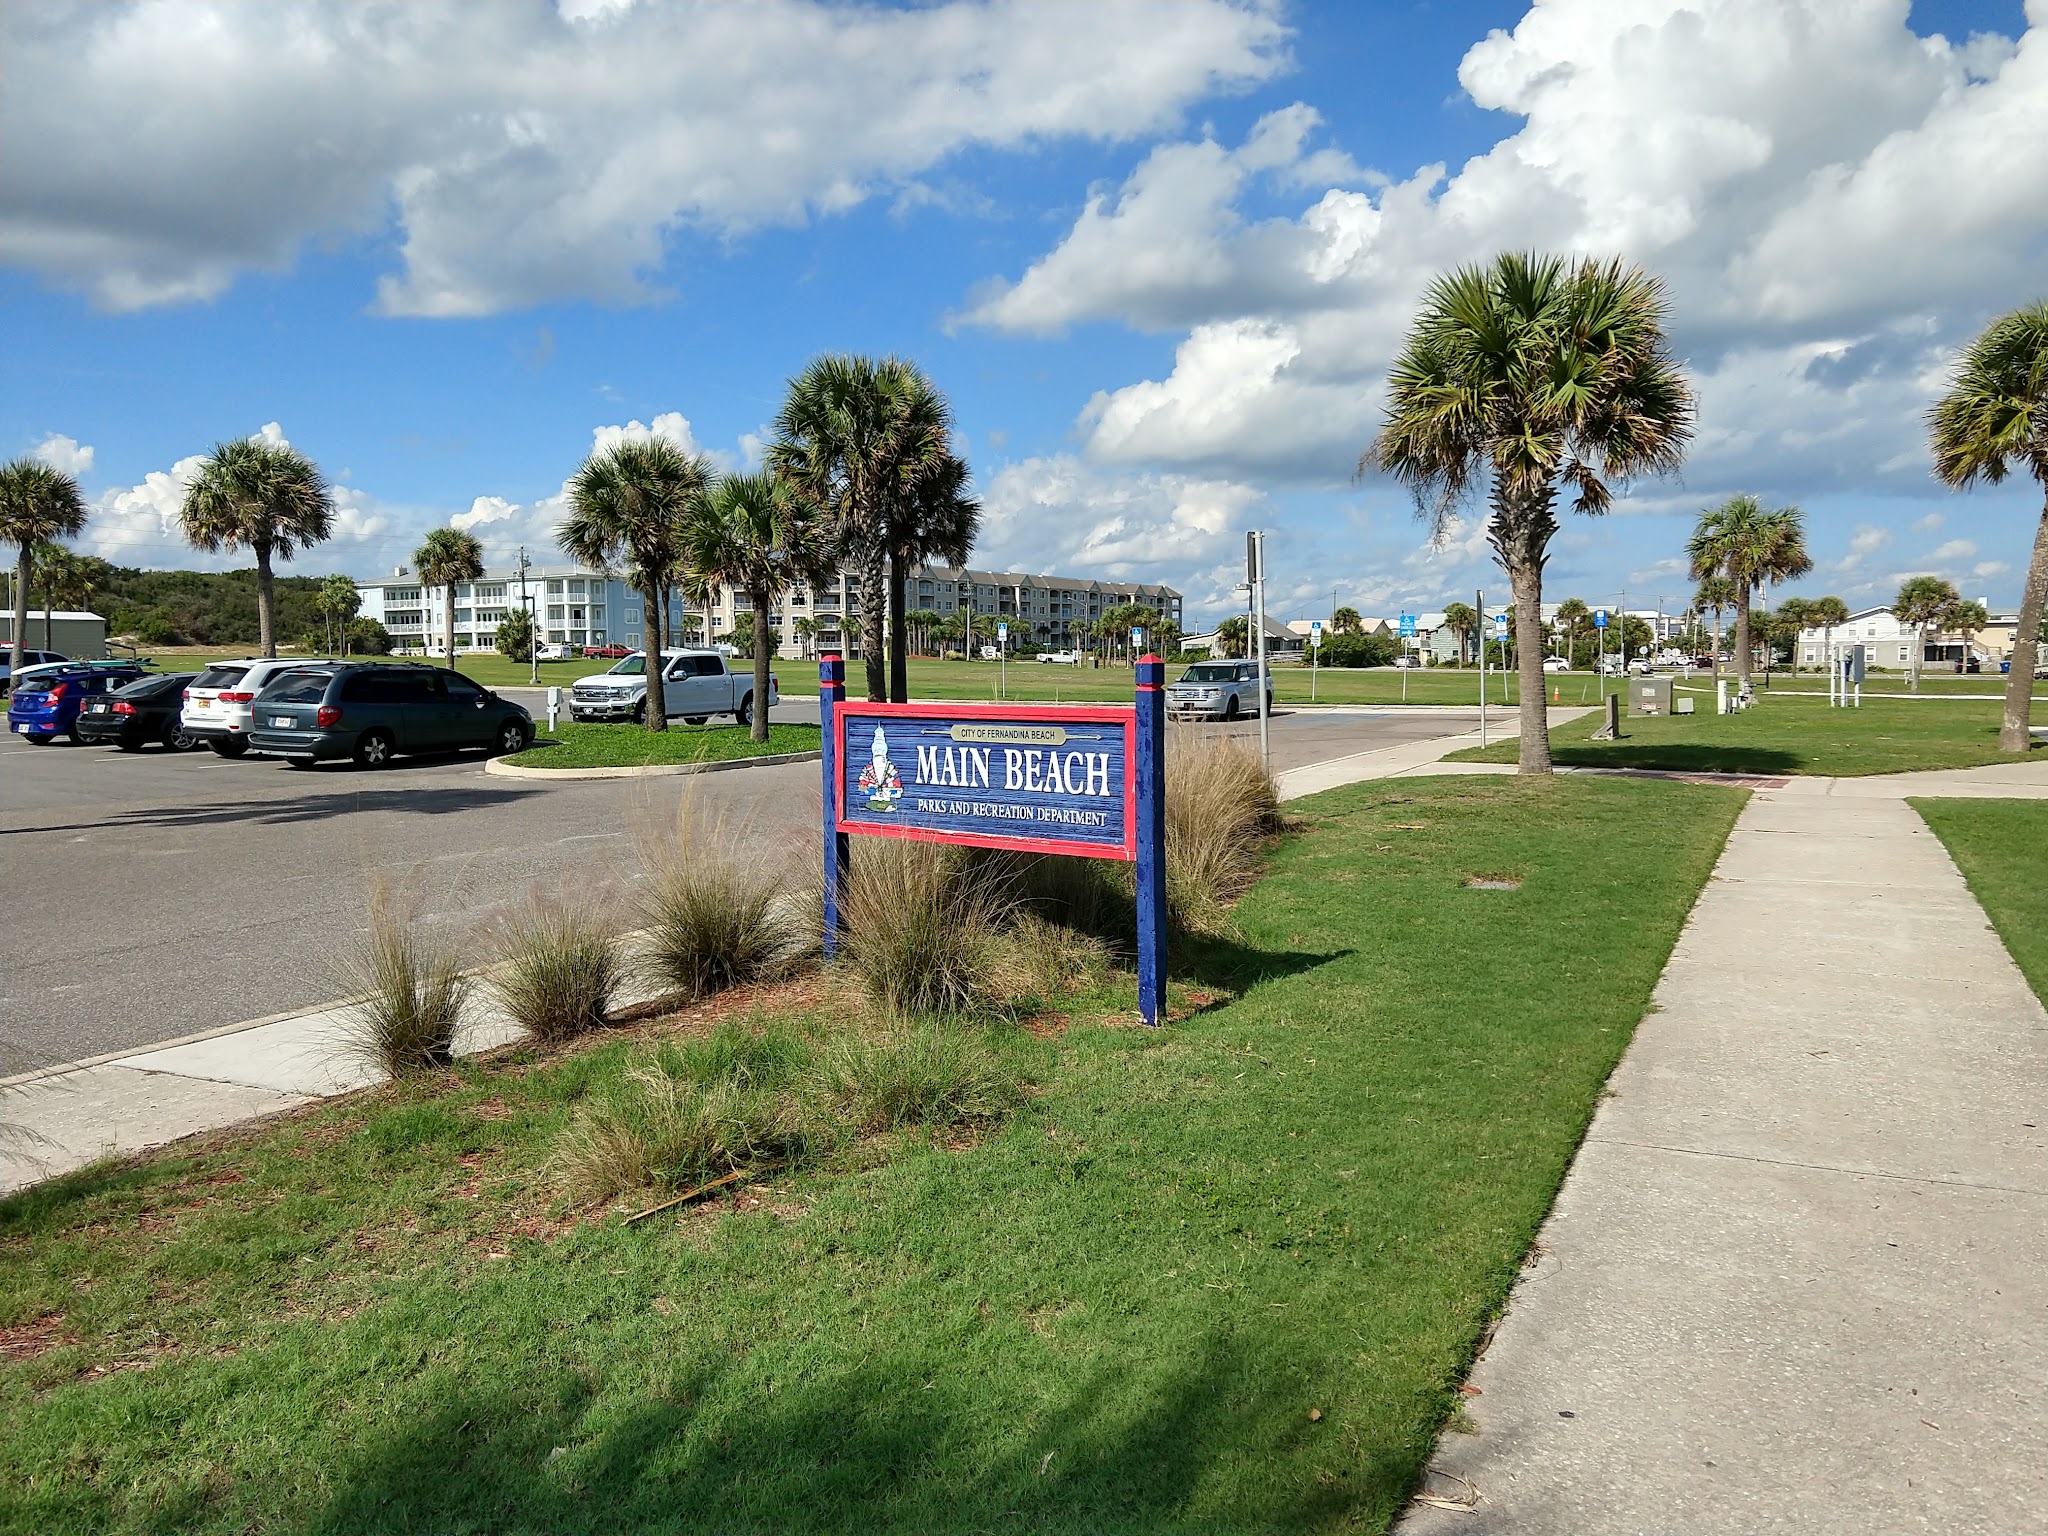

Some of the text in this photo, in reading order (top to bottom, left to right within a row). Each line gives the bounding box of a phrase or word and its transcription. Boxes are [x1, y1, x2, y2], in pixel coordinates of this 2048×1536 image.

[961, 729, 1055, 740] CITY OF FERNANDINA BEACH
[915, 745, 1110, 797] MAIN BEACH
[918, 799, 1107, 827] PARKS AND RECREATION DEPARTMENT
